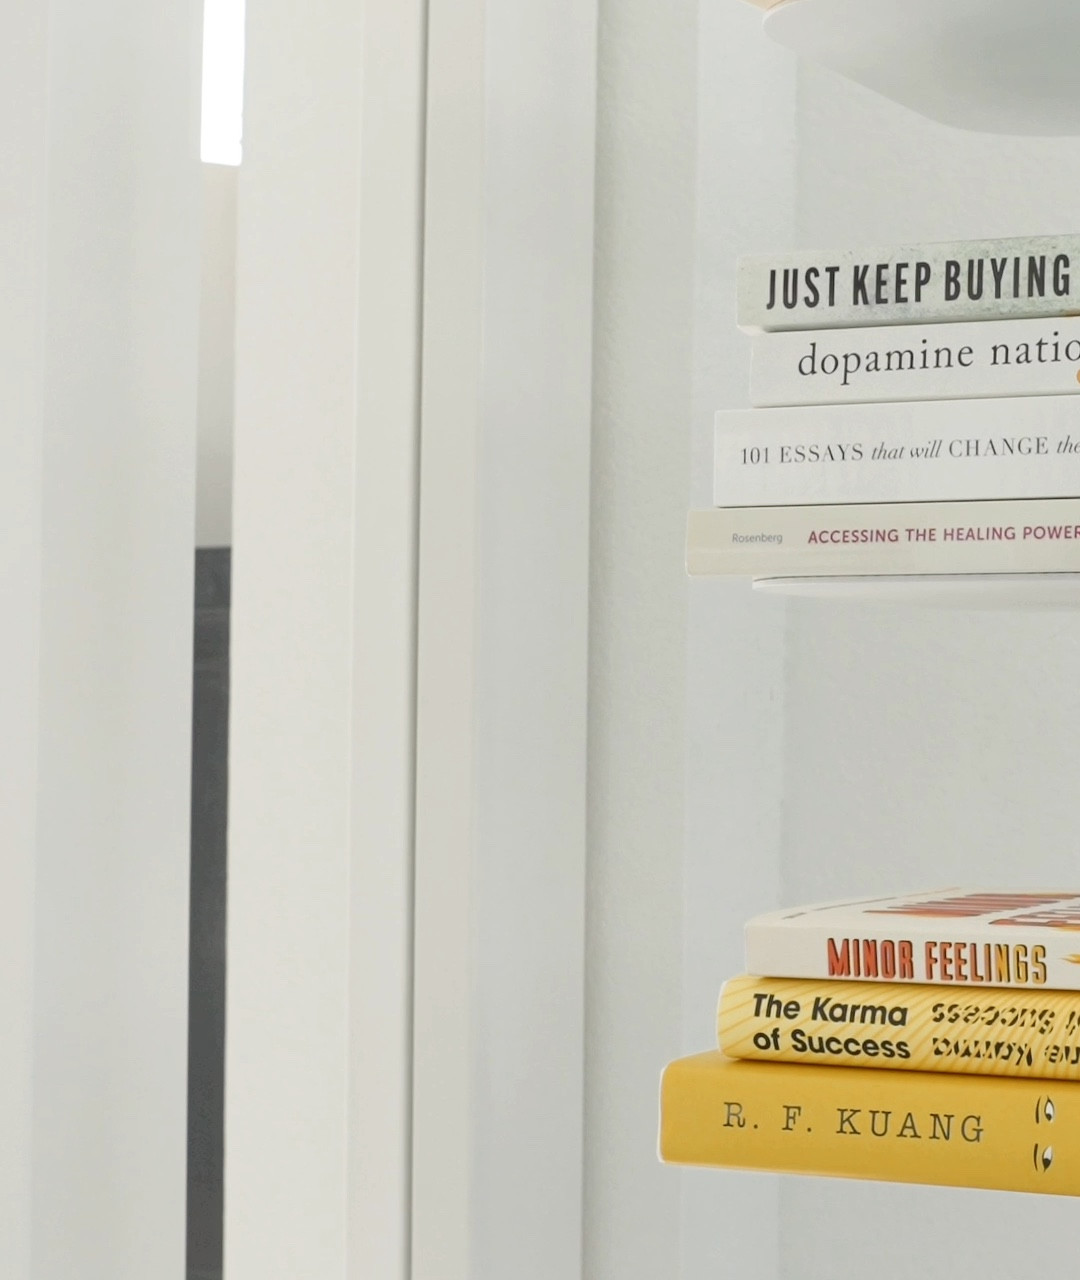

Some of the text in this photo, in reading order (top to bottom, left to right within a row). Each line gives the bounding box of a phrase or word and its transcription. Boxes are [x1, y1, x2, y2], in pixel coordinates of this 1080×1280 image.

[766, 253, 1071, 310] JUST KEEP BUYING
[797, 338, 974, 386] dopamine
[741, 445, 770, 466] 101
[780, 442, 864, 464] ESSAYS
[871, 441, 906, 461] that
[909, 439, 942, 459] will
[948, 436, 1049, 459] CHANGE
[731, 532, 783, 545] Rosenberg
[808, 529, 899, 545] ACCESSING
[905, 528, 937, 543] THE
[943, 526, 1016, 542] HEALING
[827, 937, 1047, 985] MINOR FEELINGS
[752, 993, 908, 1026] The Karma
[753, 1028, 911, 1059] of Success
[722, 1101, 985, 1144] R. F. KUANG
